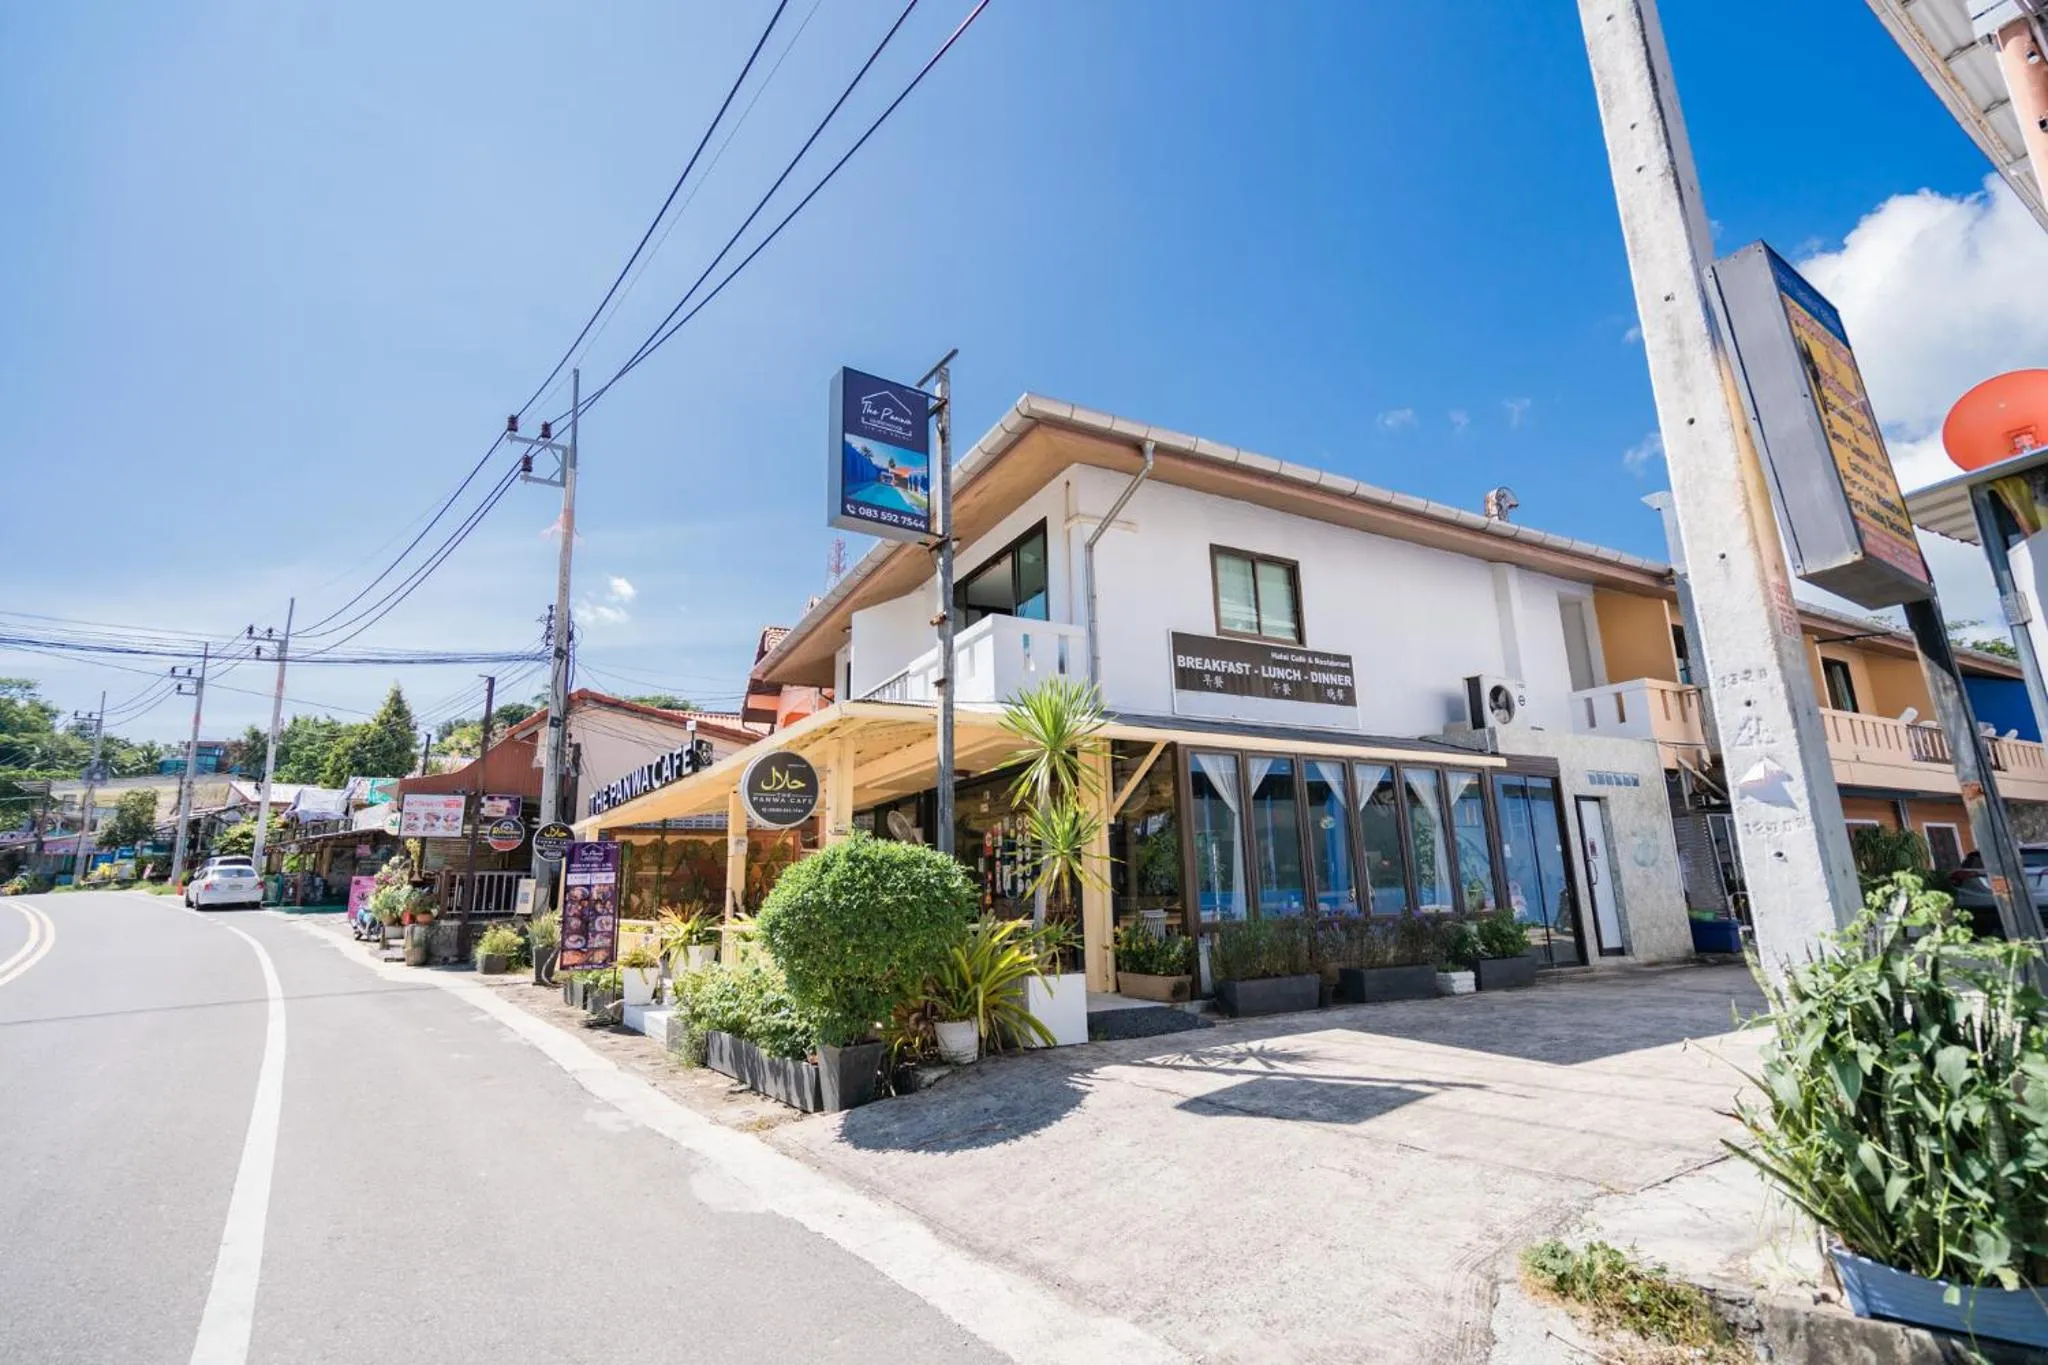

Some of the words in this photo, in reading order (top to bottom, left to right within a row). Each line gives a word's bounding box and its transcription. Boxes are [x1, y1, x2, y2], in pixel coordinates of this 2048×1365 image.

[861, 400, 880, 416] The
[858, 506, 879, 518] 083
[880, 511, 899, 523] 592
[900, 515, 926, 530] 7544
[1176, 654, 1252, 675] BREAKFAST
[1261, 665, 1302, 682] LUNCH
[1310, 671, 1353, 687] DINNER
[588, 784, 611, 817] THE
[608, 763, 651, 807] PANWA
[651, 742, 694, 790] CAFE
